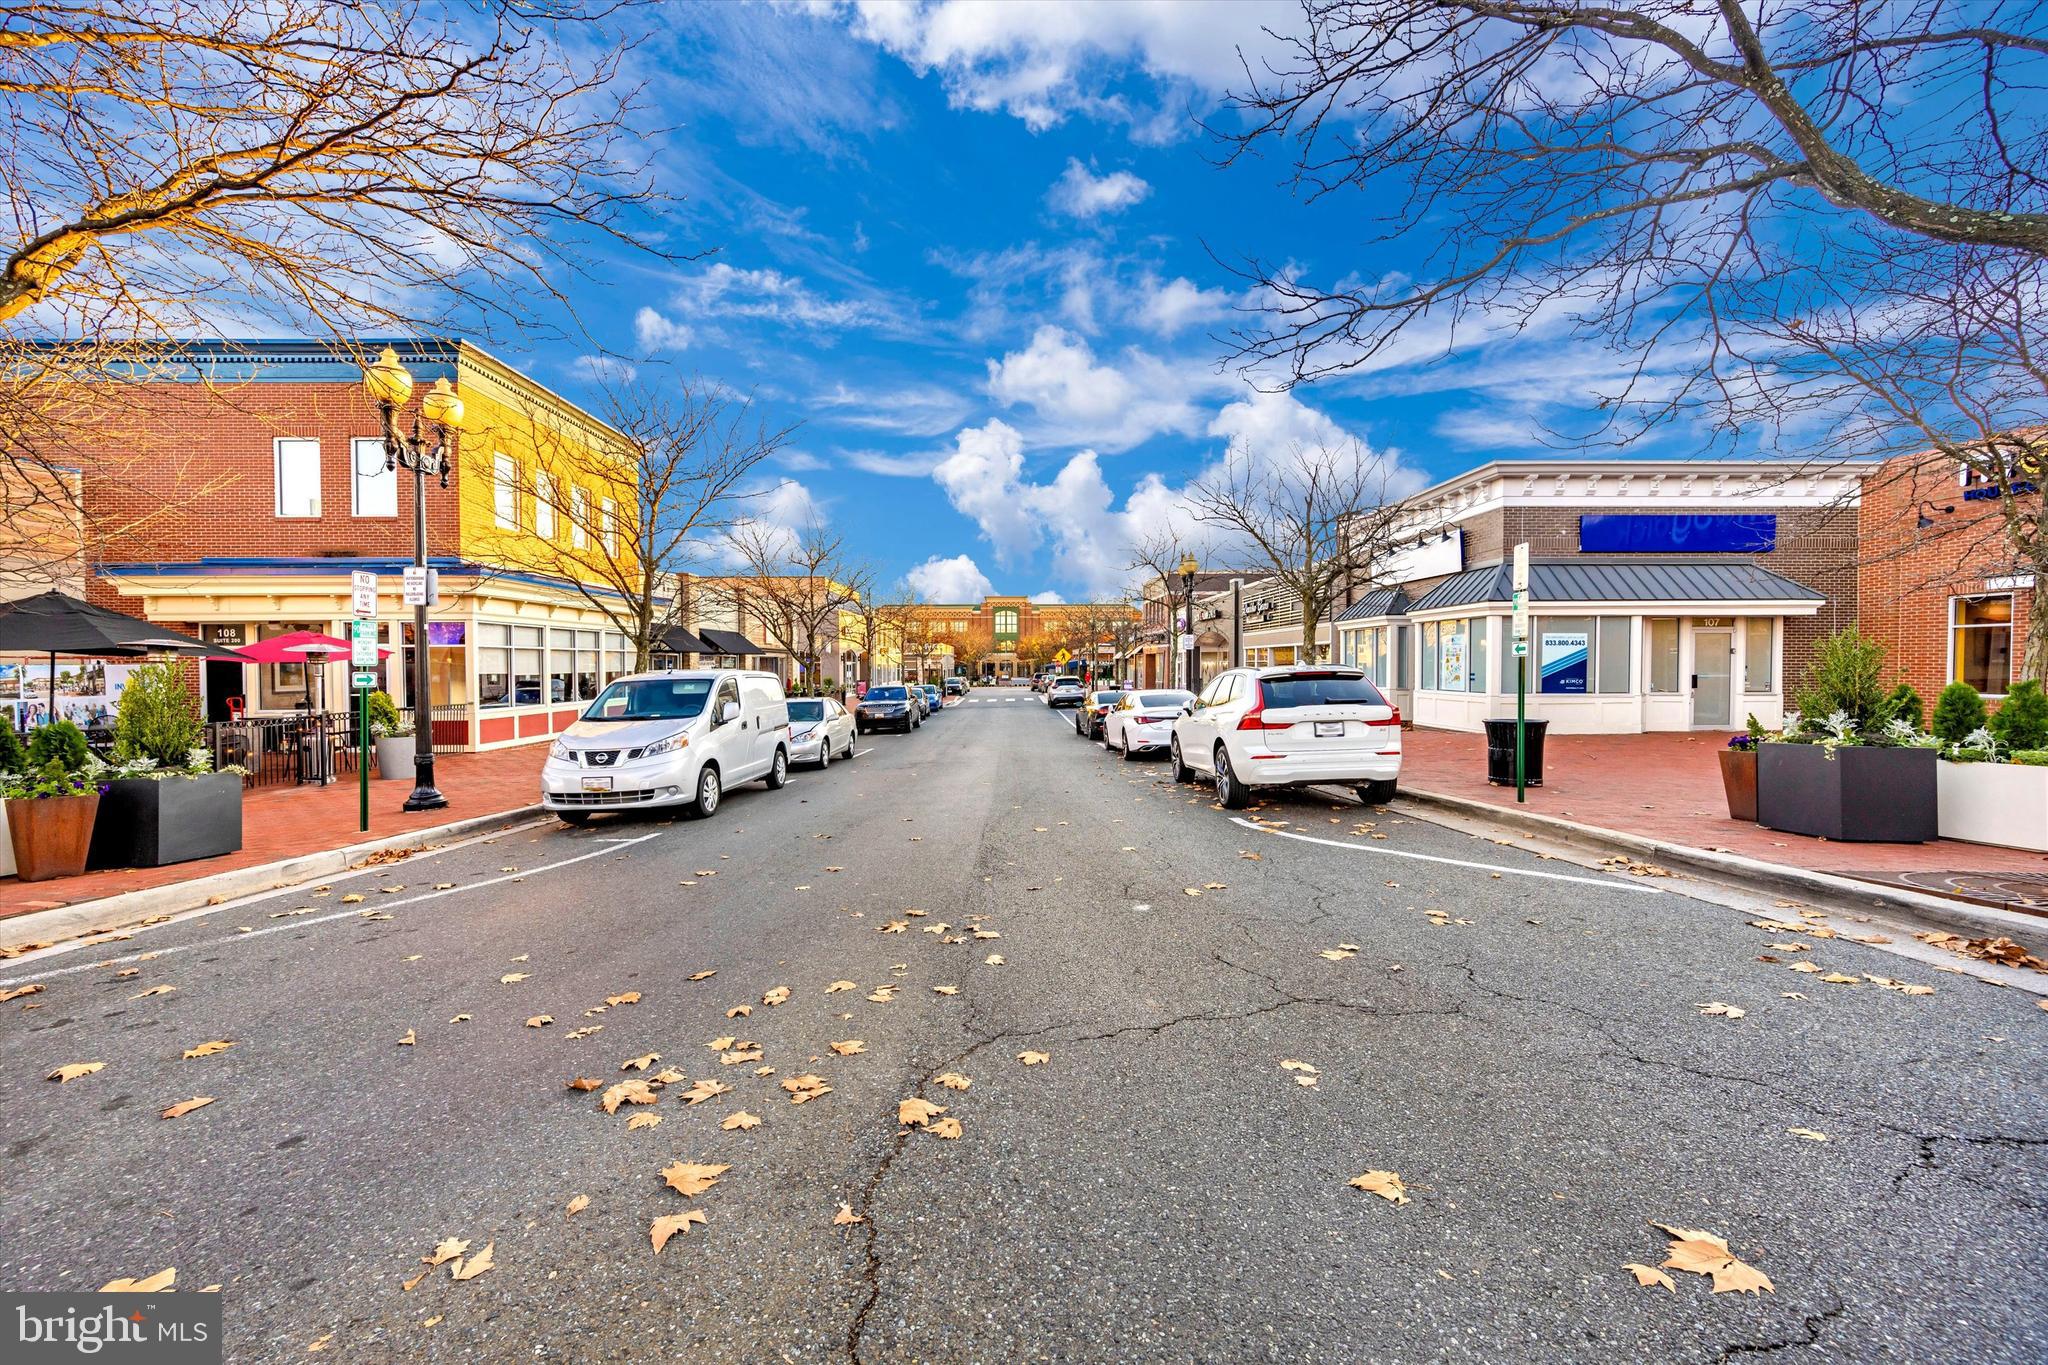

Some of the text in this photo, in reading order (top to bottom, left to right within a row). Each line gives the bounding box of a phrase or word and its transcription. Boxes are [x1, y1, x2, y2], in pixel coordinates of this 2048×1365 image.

[360, 575, 370, 585] NO
[360, 600, 371, 608] TIME
[1703, 618, 1720, 627] 107
[217, 628, 236, 638] 108
